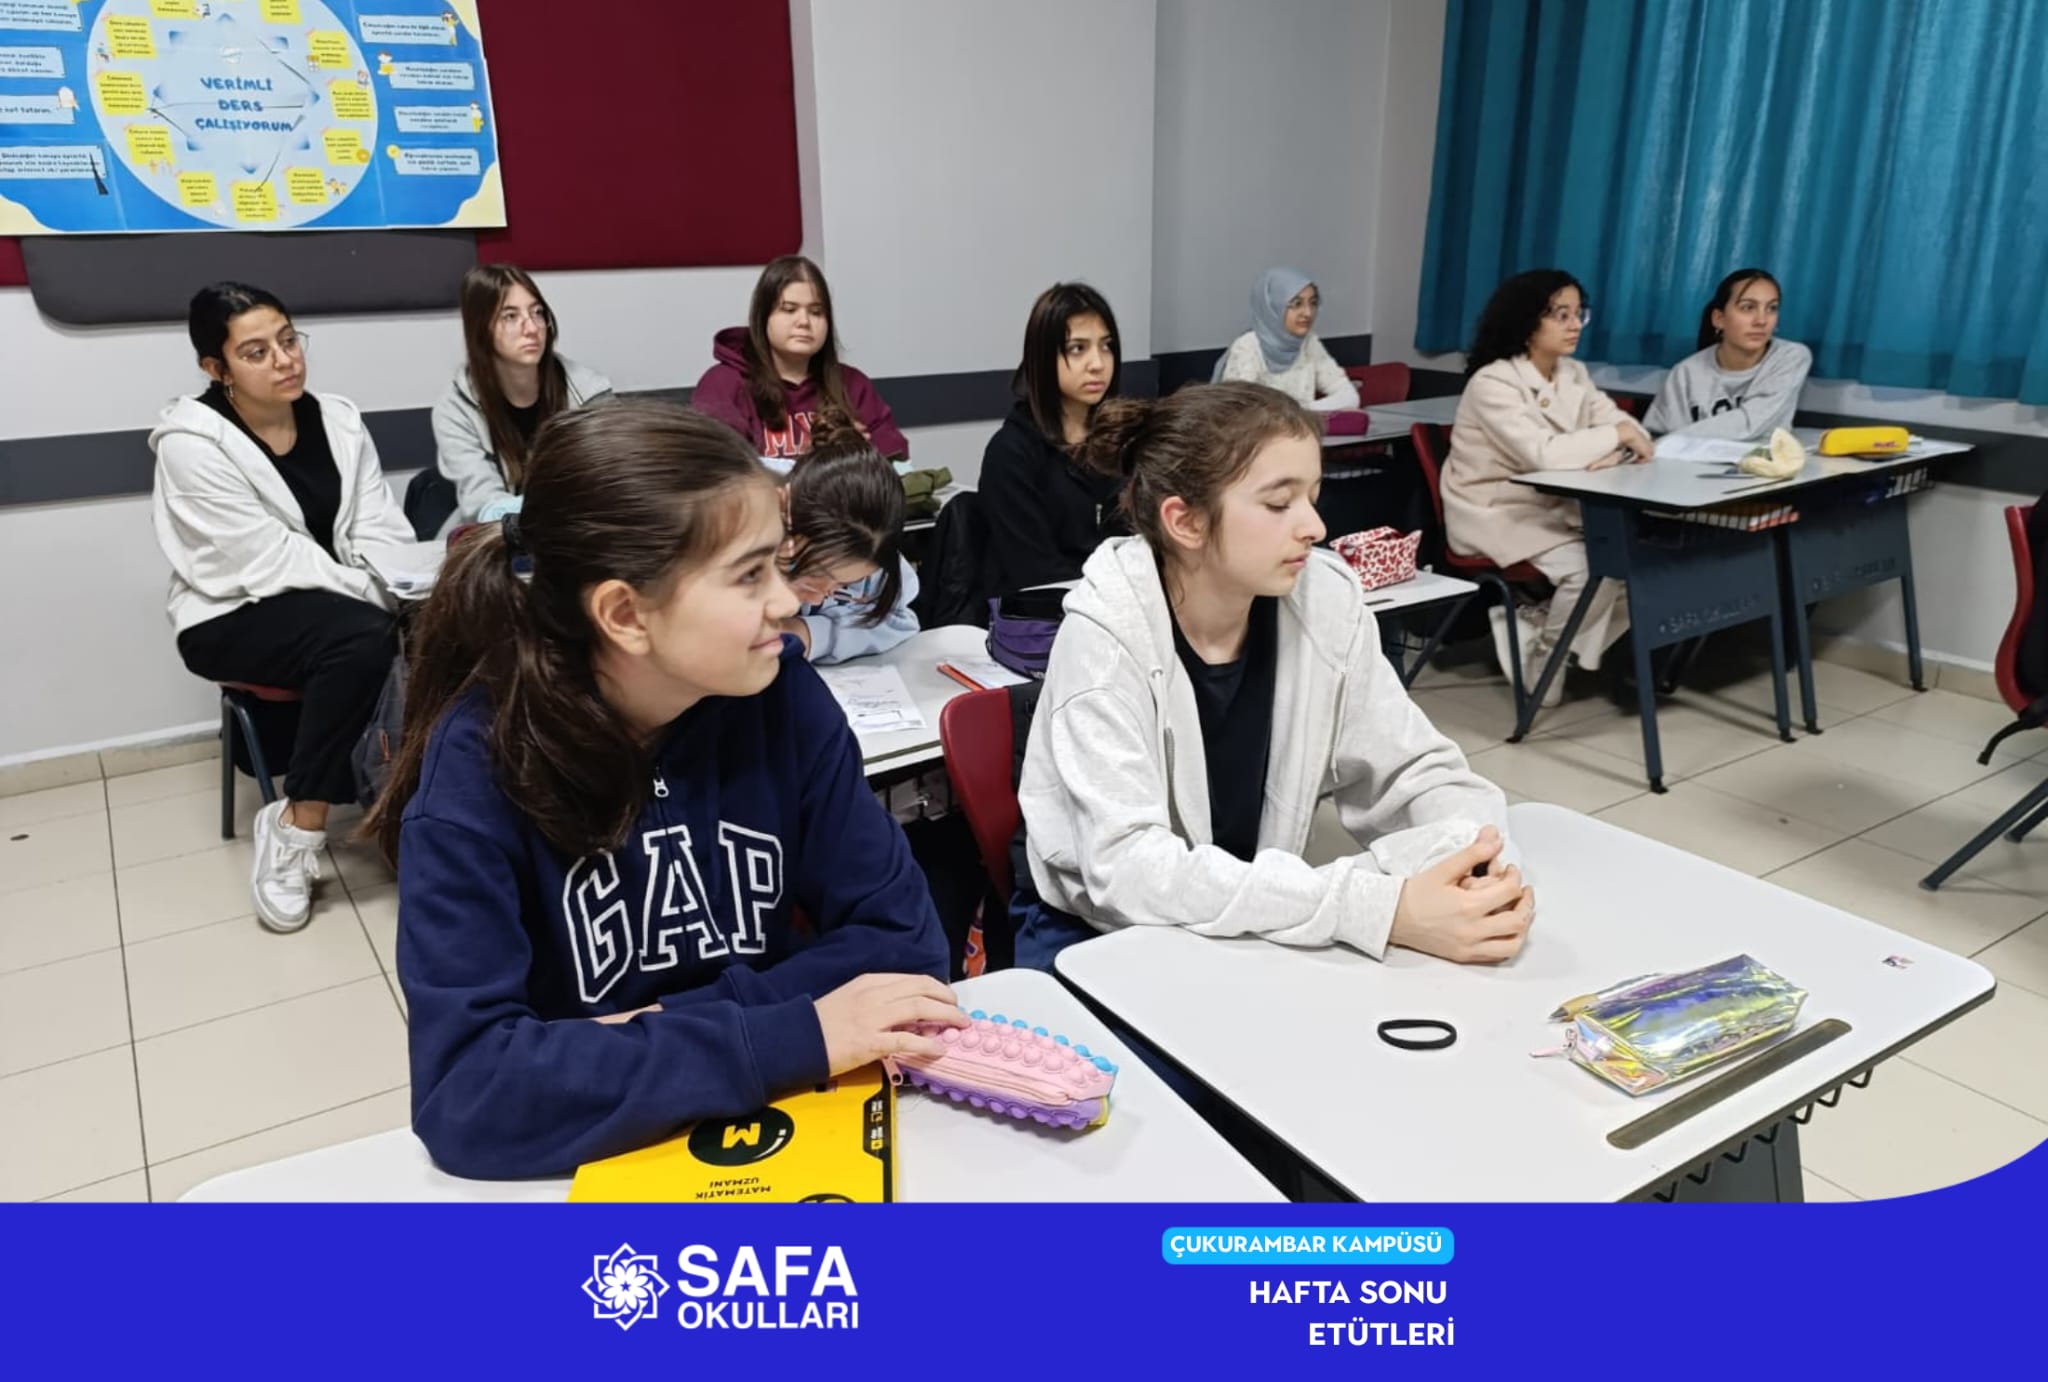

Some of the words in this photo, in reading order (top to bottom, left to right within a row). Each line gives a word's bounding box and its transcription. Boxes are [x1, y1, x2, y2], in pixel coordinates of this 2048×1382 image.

[218, 99, 263, 112] DERS
[195, 118, 293, 132] ÇALIŞIYORUM
[563, 820, 783, 1003] GAP
[722, 1122, 761, 1150] M
[710, 1176, 760, 1188] UZMANI
[696, 1185, 772, 1200] MATEMATİK
